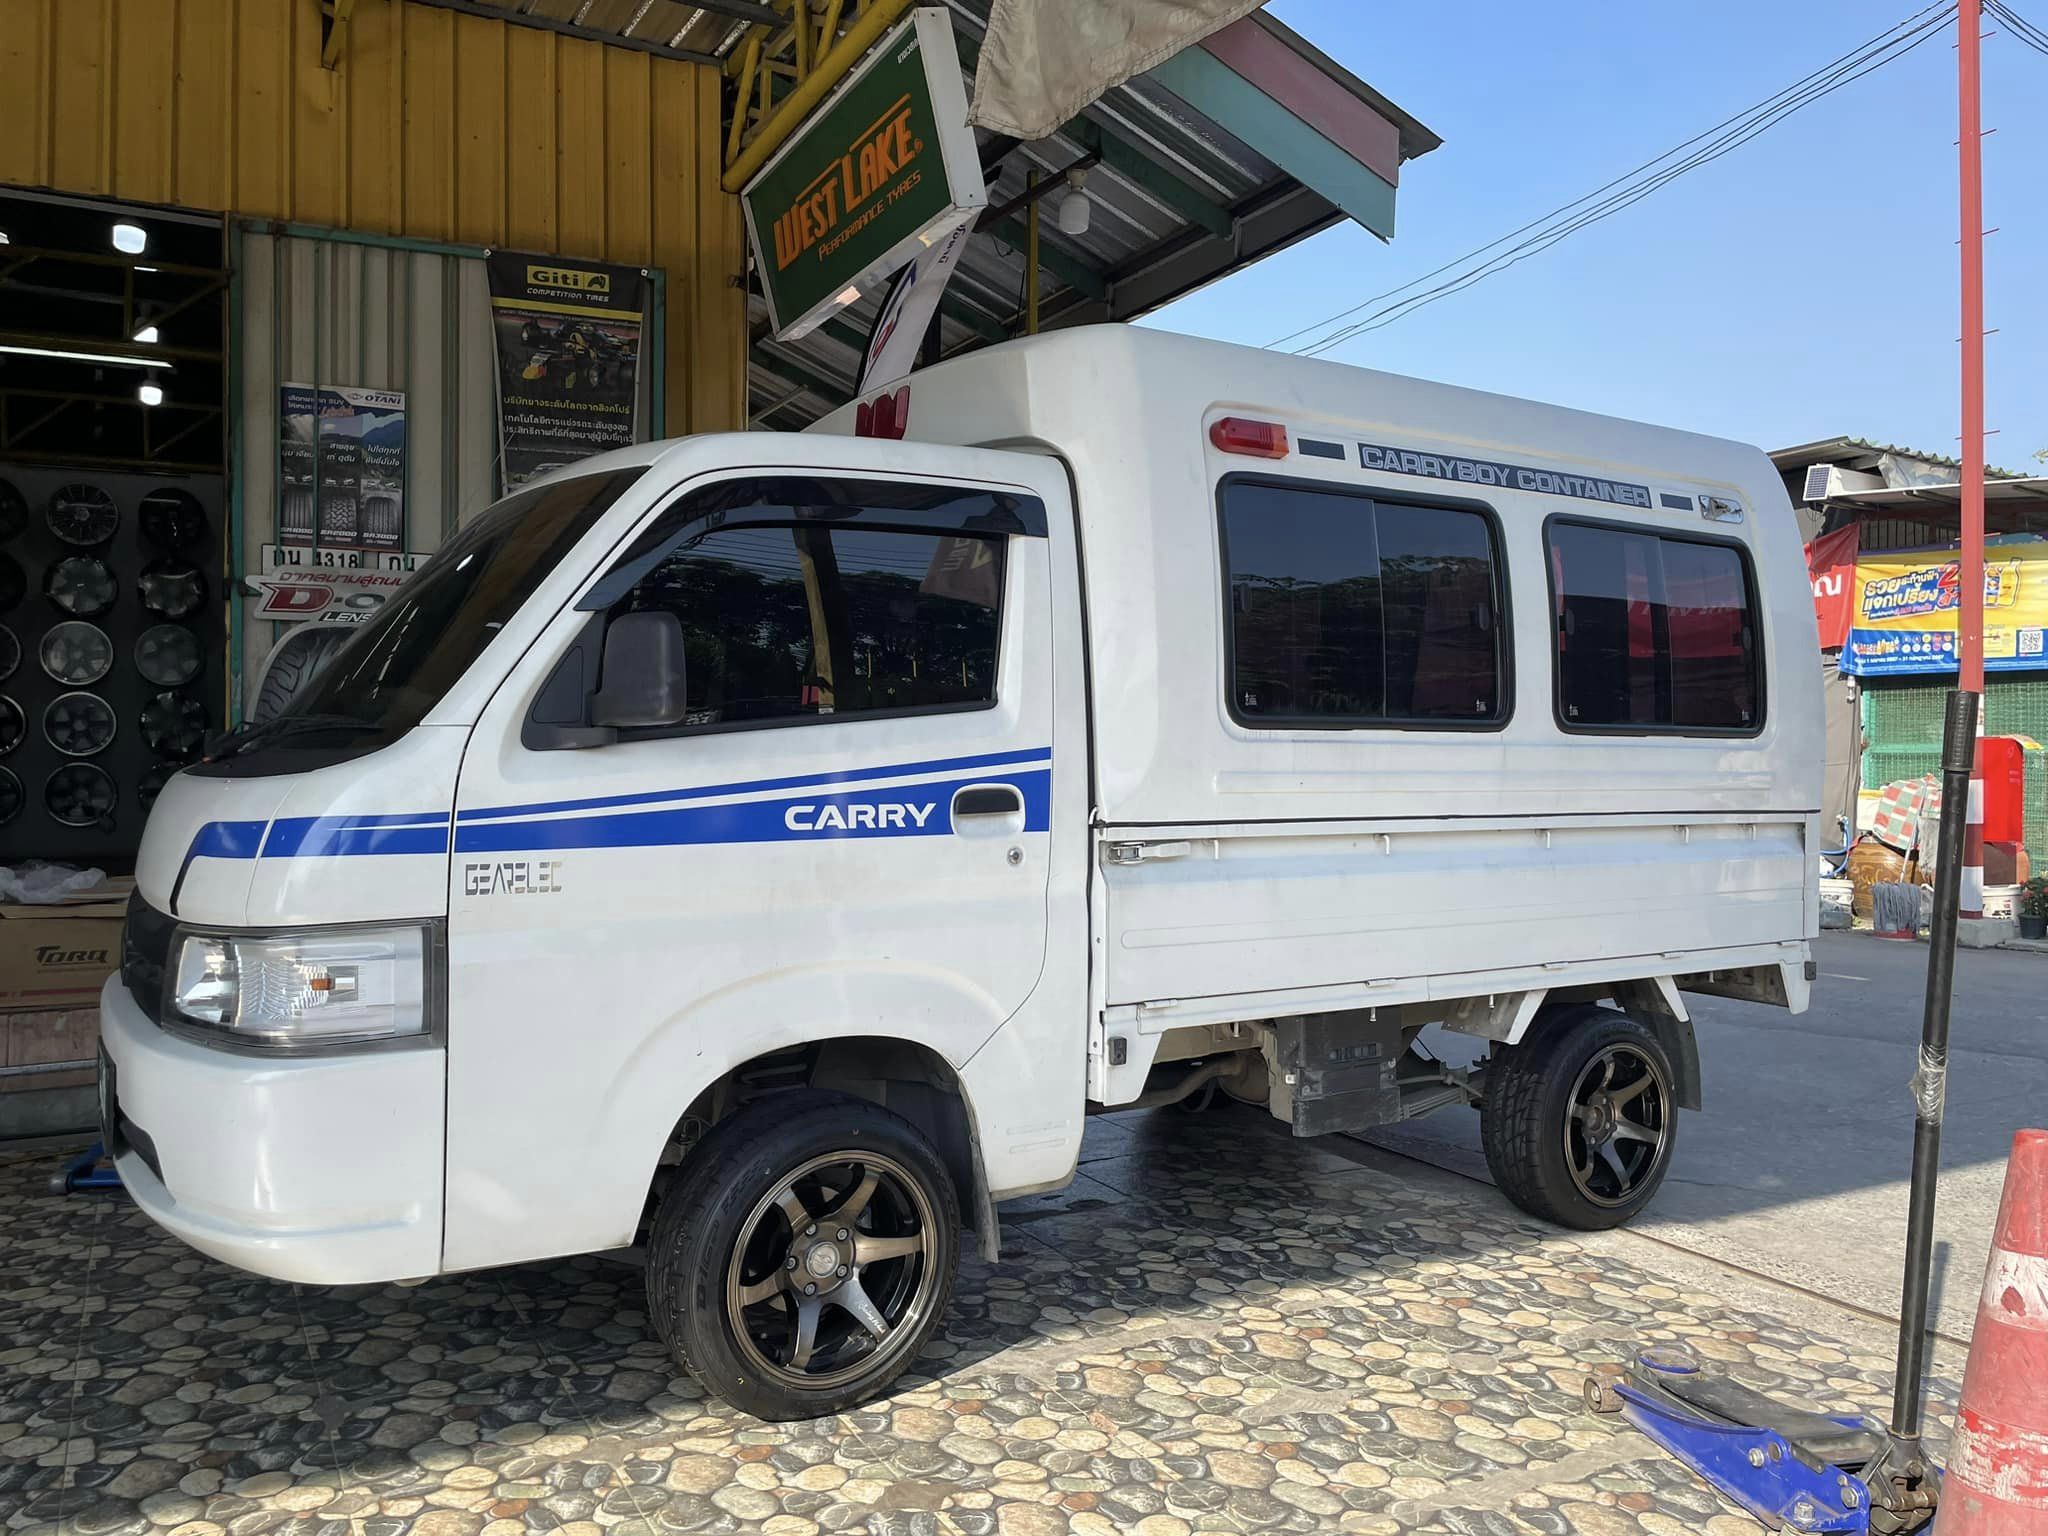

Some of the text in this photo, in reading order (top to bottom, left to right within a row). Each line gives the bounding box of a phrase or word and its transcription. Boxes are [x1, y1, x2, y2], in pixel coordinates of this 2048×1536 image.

[772, 177, 839, 271] WEST
[818, 199, 885, 262] PERFORMANCE
[887, 170, 921, 206] TYRES
[527, 287, 582, 299] COMPETITION
[532, 270, 579, 286] Giti
[365, 394, 401, 405] OTANI
[1361, 446, 1650, 508] CARRYBOY CONTAINER
[784, 802, 937, 831] CARRY
[464, 860, 563, 896] GEARELEC
